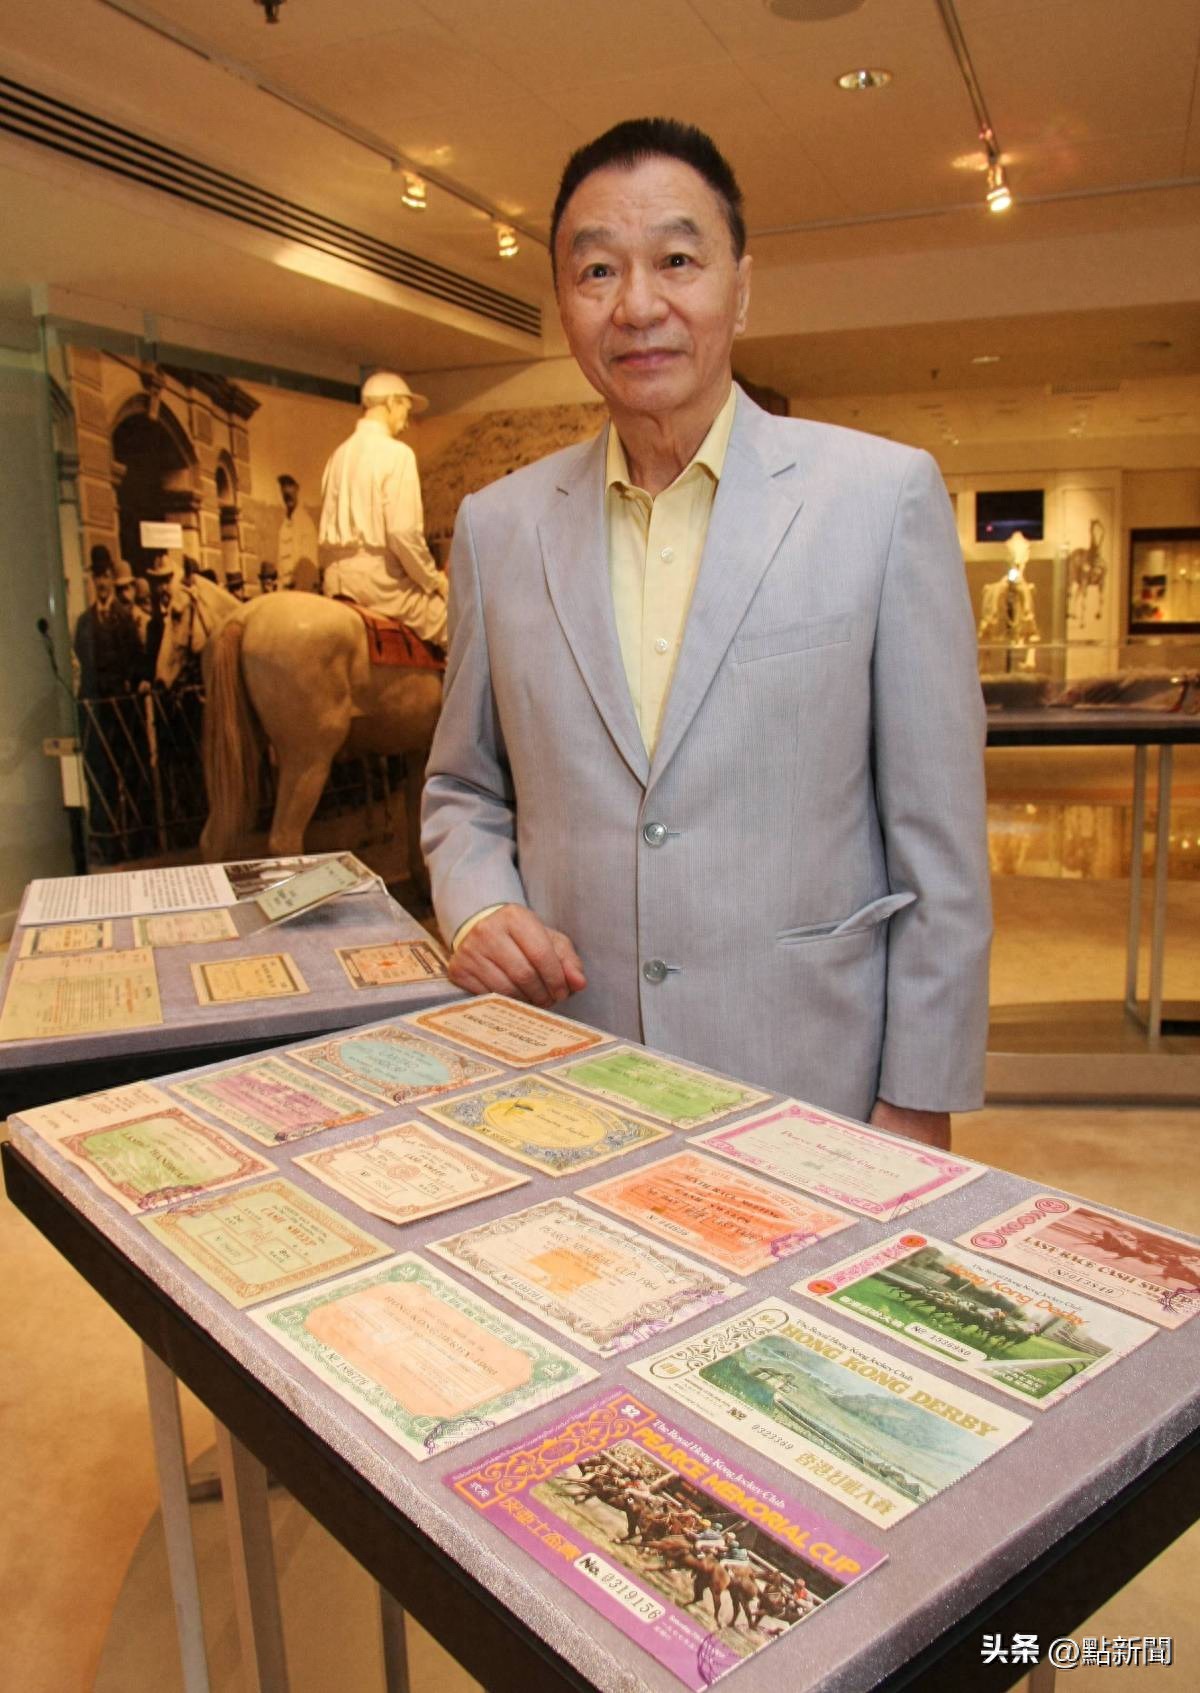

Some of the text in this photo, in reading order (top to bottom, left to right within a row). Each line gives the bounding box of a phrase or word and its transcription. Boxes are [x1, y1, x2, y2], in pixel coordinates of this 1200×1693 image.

[986, 1280, 1038, 1302] Kong
[1097, 1265, 1137, 1283] CASH
[778, 1325, 997, 1436] HONG KONG DERBY
[793, 1320, 915, 1381] The Royal Hong Kong Jockey Club
[648, 1419, 788, 1508] The Royal Hong Kong Jockey Club
[631, 1429, 863, 1577] PEARCE MEMORIAL CUP
[578, 1555, 661, 1619] No. 0319156
